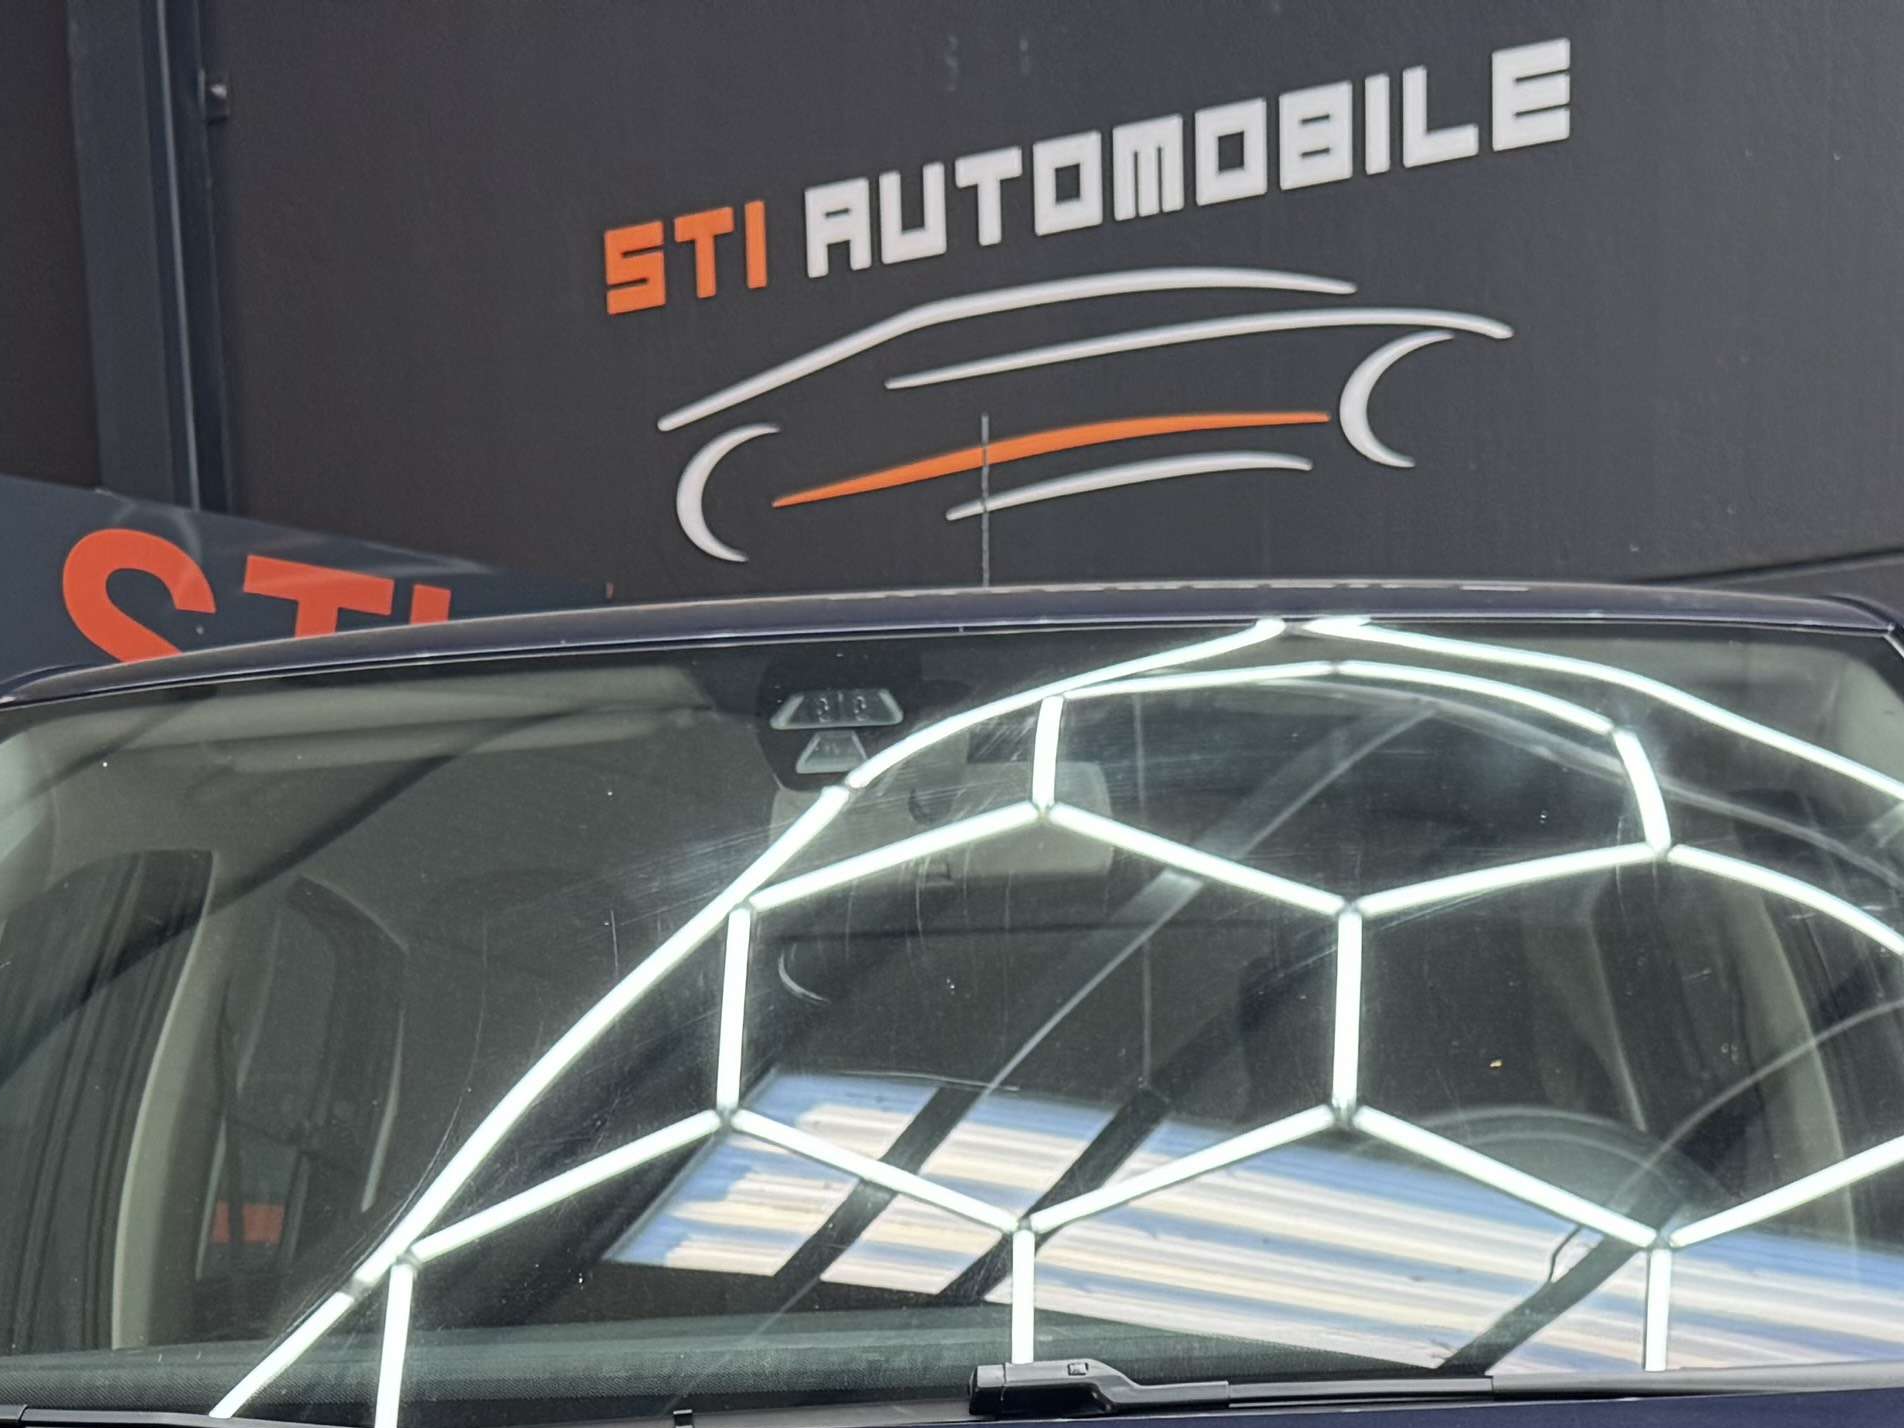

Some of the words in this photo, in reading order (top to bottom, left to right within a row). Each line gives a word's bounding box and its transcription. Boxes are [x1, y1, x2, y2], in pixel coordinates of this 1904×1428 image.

[604, 200, 768, 314] STI
[804, 37, 1571, 279] AUTOMOBILE
[62, 528, 451, 663] ST
